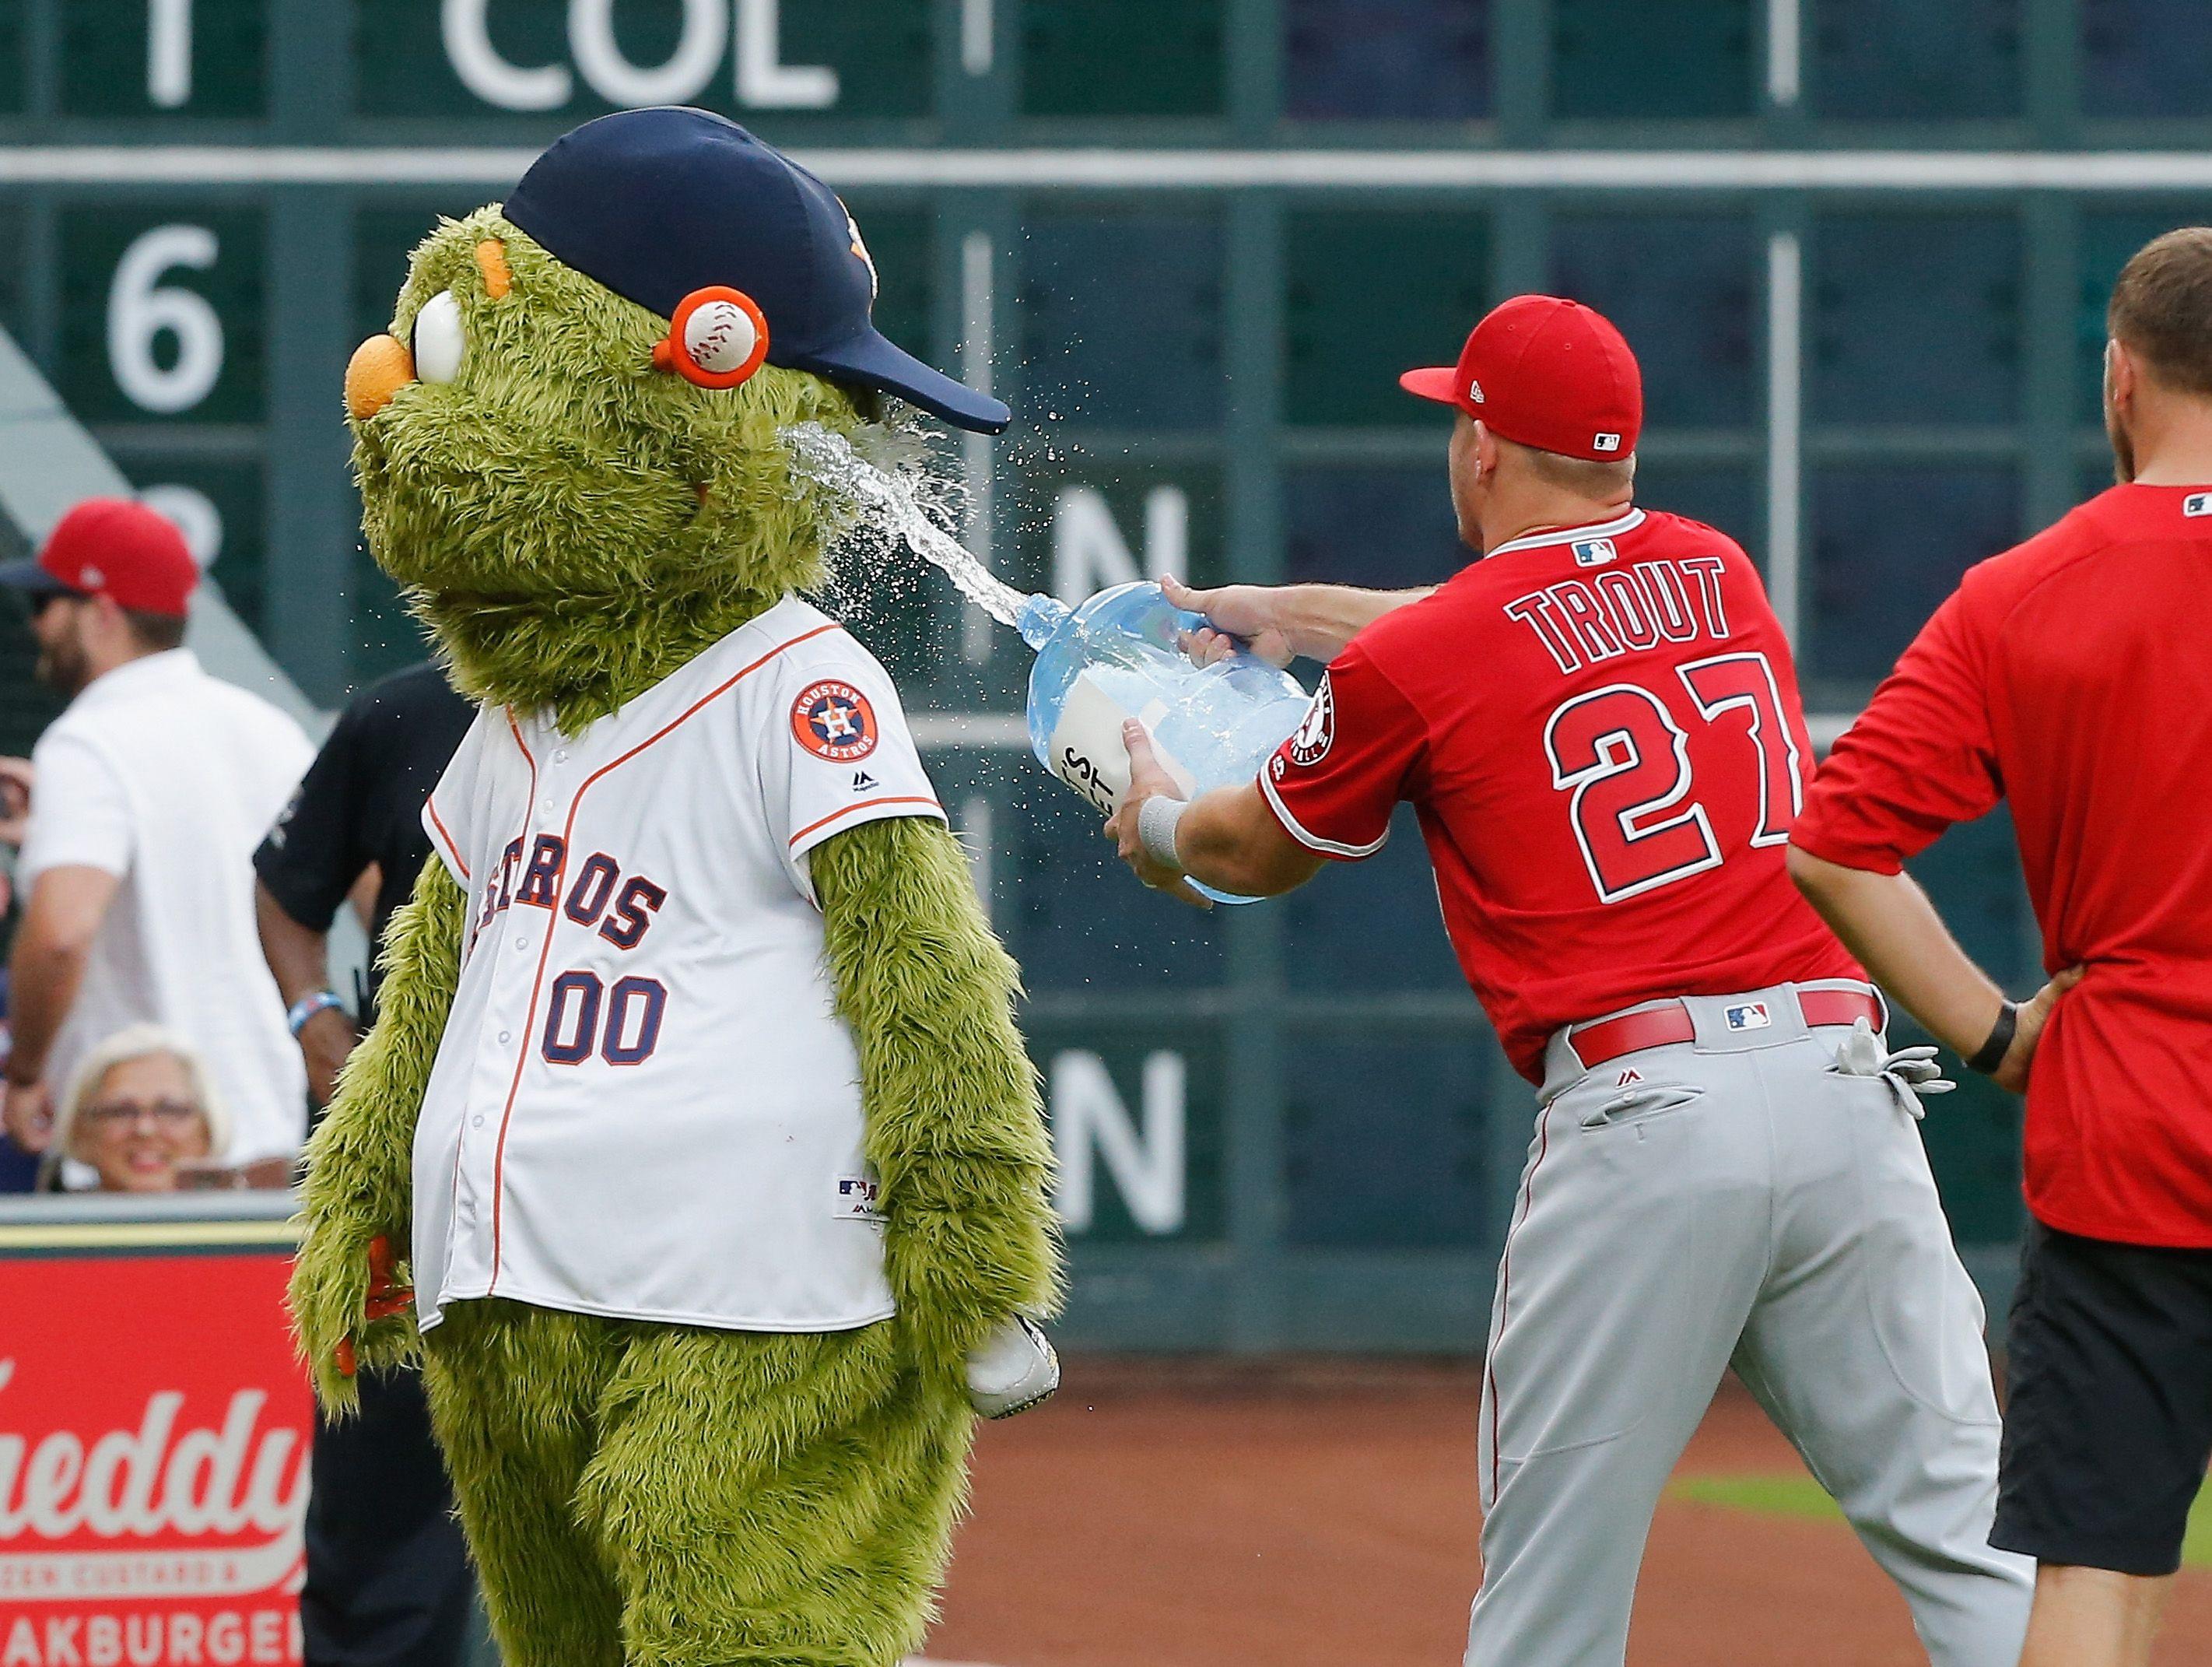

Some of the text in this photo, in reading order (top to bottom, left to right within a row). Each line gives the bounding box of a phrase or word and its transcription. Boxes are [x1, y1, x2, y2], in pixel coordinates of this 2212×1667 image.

[442, 0, 839, 111] COL
[108, 225, 223, 412] 6
[1503, 556, 1725, 674] TROUT
[798, 685, 861, 715] HOUSTON
[818, 735, 873, 757] ASTROS
[1543, 651, 1804, 905] 27
[542, 970, 668, 1065] 00
[1053, 1051, 1185, 1232] N
